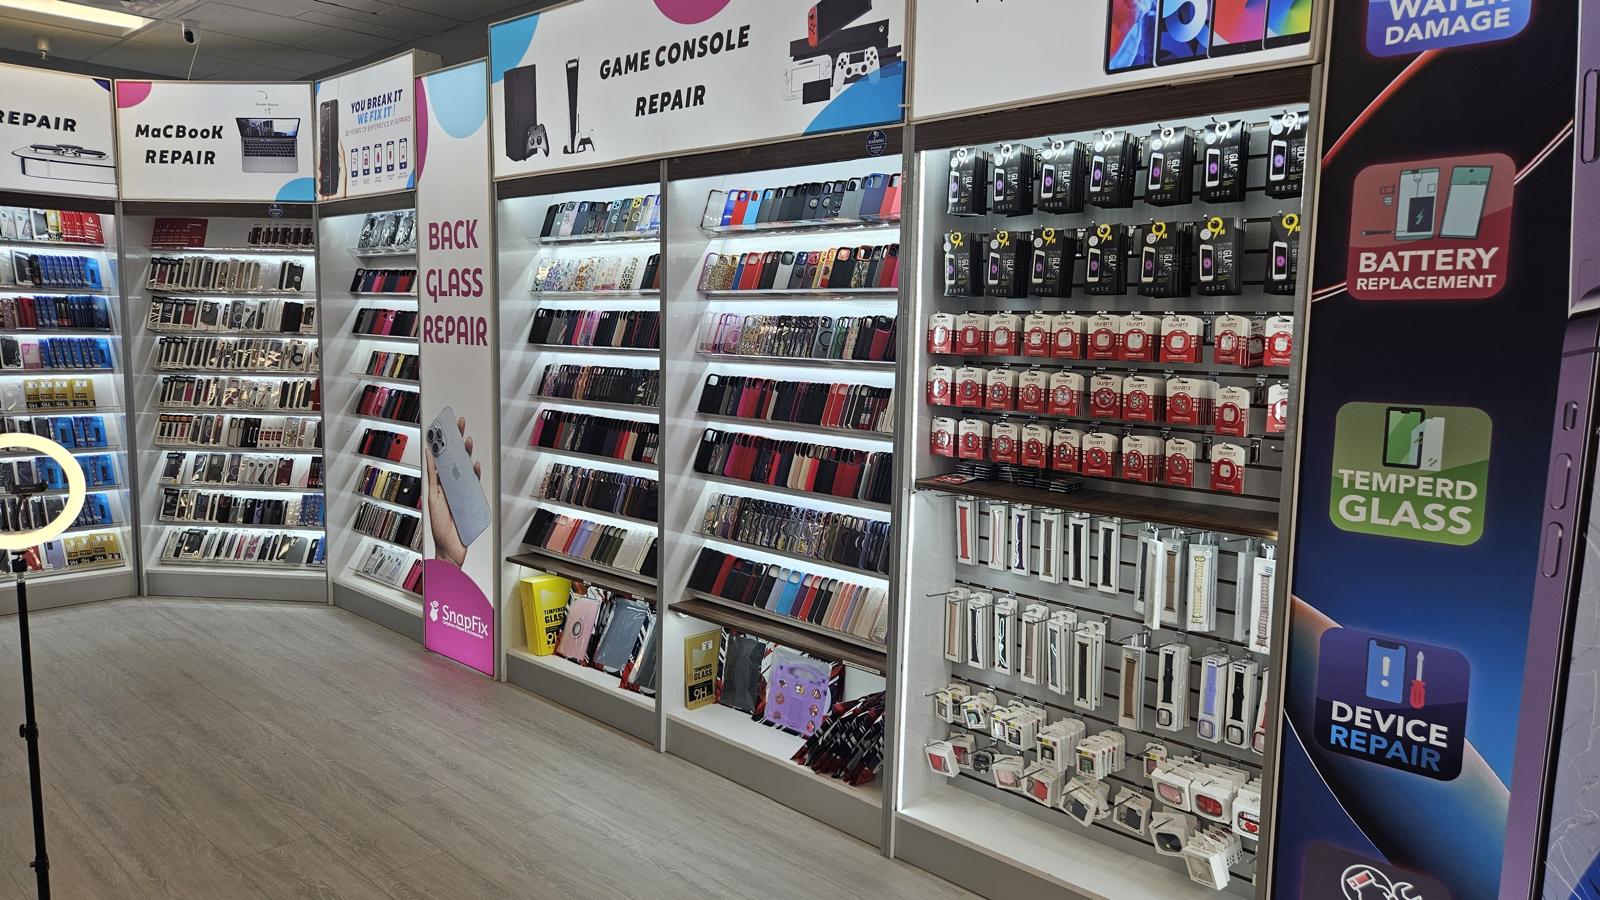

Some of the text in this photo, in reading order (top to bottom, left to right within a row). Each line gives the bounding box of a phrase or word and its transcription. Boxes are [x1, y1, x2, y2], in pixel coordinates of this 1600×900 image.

[1384, 7, 1511, 46] DAMAGE
[599, 24, 751, 80] GAME CONSOLE
[351, 88, 403, 114] YOU BREAK IT
[356, 112, 368, 124] WE
[370, 108, 382, 122] FIX
[383, 106, 392, 118] IT
[635, 84, 706, 117] REPAIR
[1215, 122, 1232, 144] 9H
[145, 150, 216, 165] REPAIR
[428, 219, 479, 250] BACK
[1358, 246, 1500, 274] BATTERY
[426, 267, 484, 303] GLASS
[1356, 274, 1497, 291] REPLACEMENT
[423, 316, 488, 347] REPAIR
[1338, 469, 1478, 500] TEMPERD
[1338, 494, 1473, 536] GLASS
[442, 604, 488, 636] SnapFix
[547, 632, 557, 646] 9
[694, 669, 712, 680] GLASS
[694, 686, 707, 701] 9H
[1331, 700, 1448, 748] DEVICE
[1330, 725, 1441, 772] REPAIR
